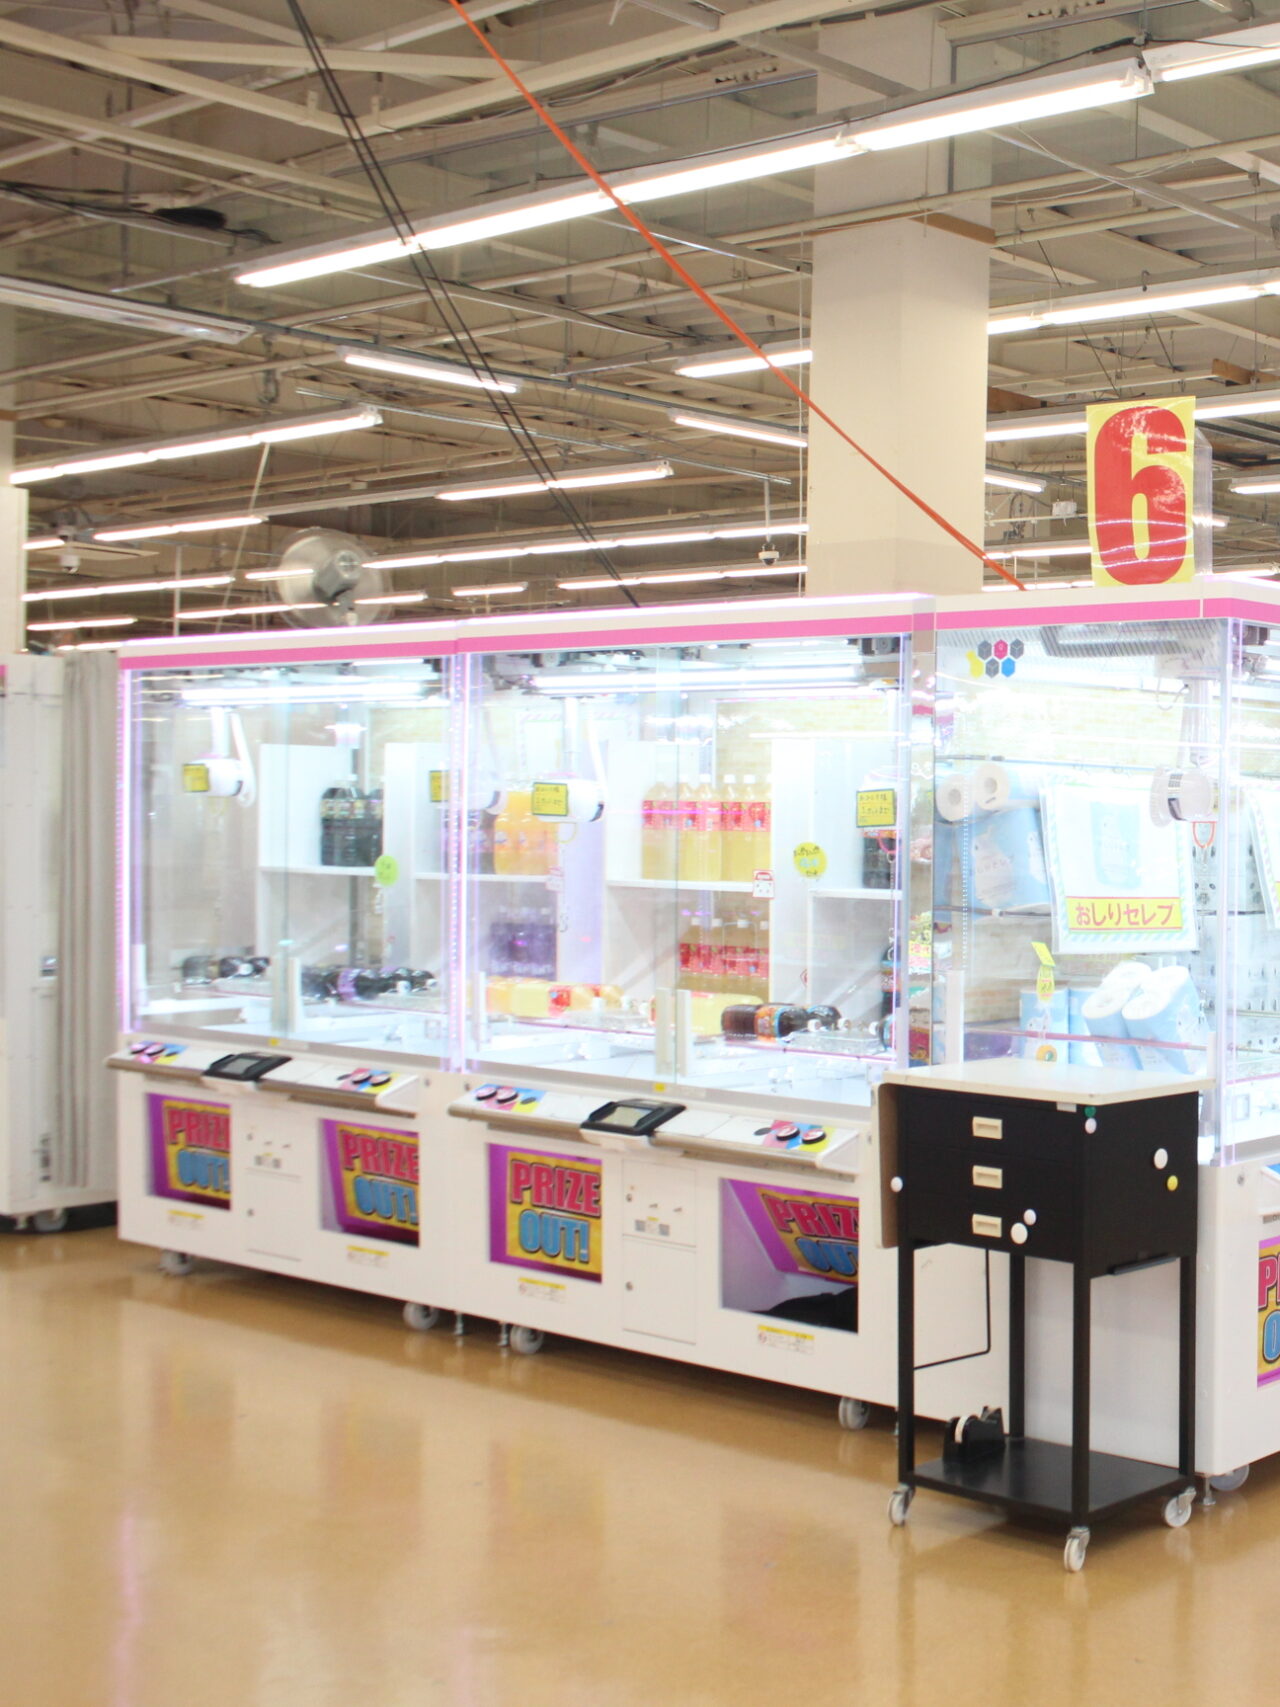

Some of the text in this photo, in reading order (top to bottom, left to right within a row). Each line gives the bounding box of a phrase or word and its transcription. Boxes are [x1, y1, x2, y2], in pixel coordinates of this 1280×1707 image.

[1095, 406, 1187, 585] 6
[166, 1107, 230, 1153] PRIZ
[340, 1129, 418, 1185] PRIZE
[354, 1175, 418, 1226] OUT!
[511, 1159, 601, 1218] PRIZE
[519, 1208, 589, 1264] OUT!
[762, 1194, 858, 1242] PRIZ
[794, 1237, 858, 1276] OU
